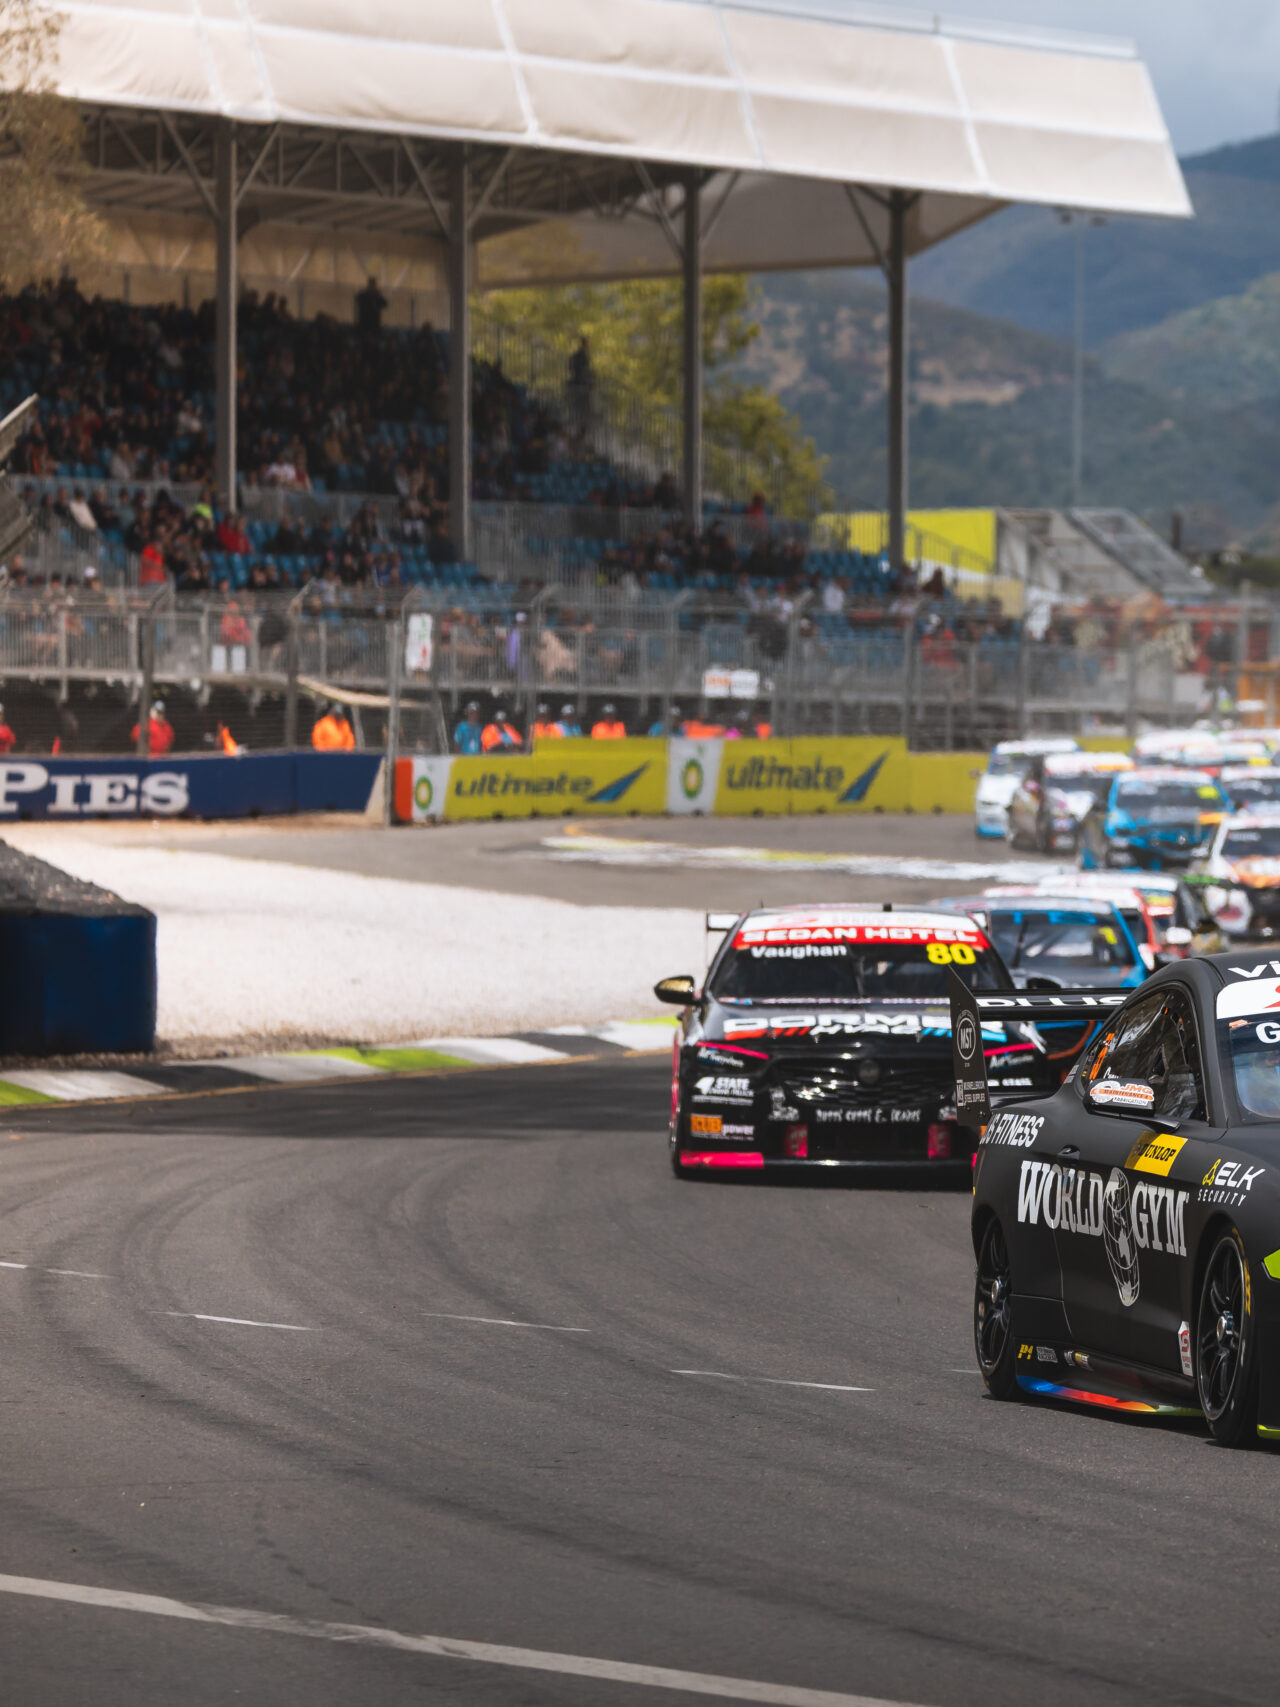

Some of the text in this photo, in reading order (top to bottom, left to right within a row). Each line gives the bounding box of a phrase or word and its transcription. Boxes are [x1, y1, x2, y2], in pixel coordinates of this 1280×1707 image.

[455, 771, 594, 797] ultimate
[726, 757, 845, 791] ultimate
[0, 763, 190, 814] PIES
[742, 928, 978, 942] SEDAN HOTEL
[751, 944, 847, 959] Vaughan
[926, 943, 976, 965] 80
[960, 1027, 973, 1050] MST
[1122, 1084, 1153, 1095] JMG
[1139, 1142, 1175, 1161] DUNLOP
[1215, 1161, 1265, 1191] ELK
[1017, 1160, 1188, 1257] WORLD GYM
[1198, 1188, 1247, 1207] SECURITY
